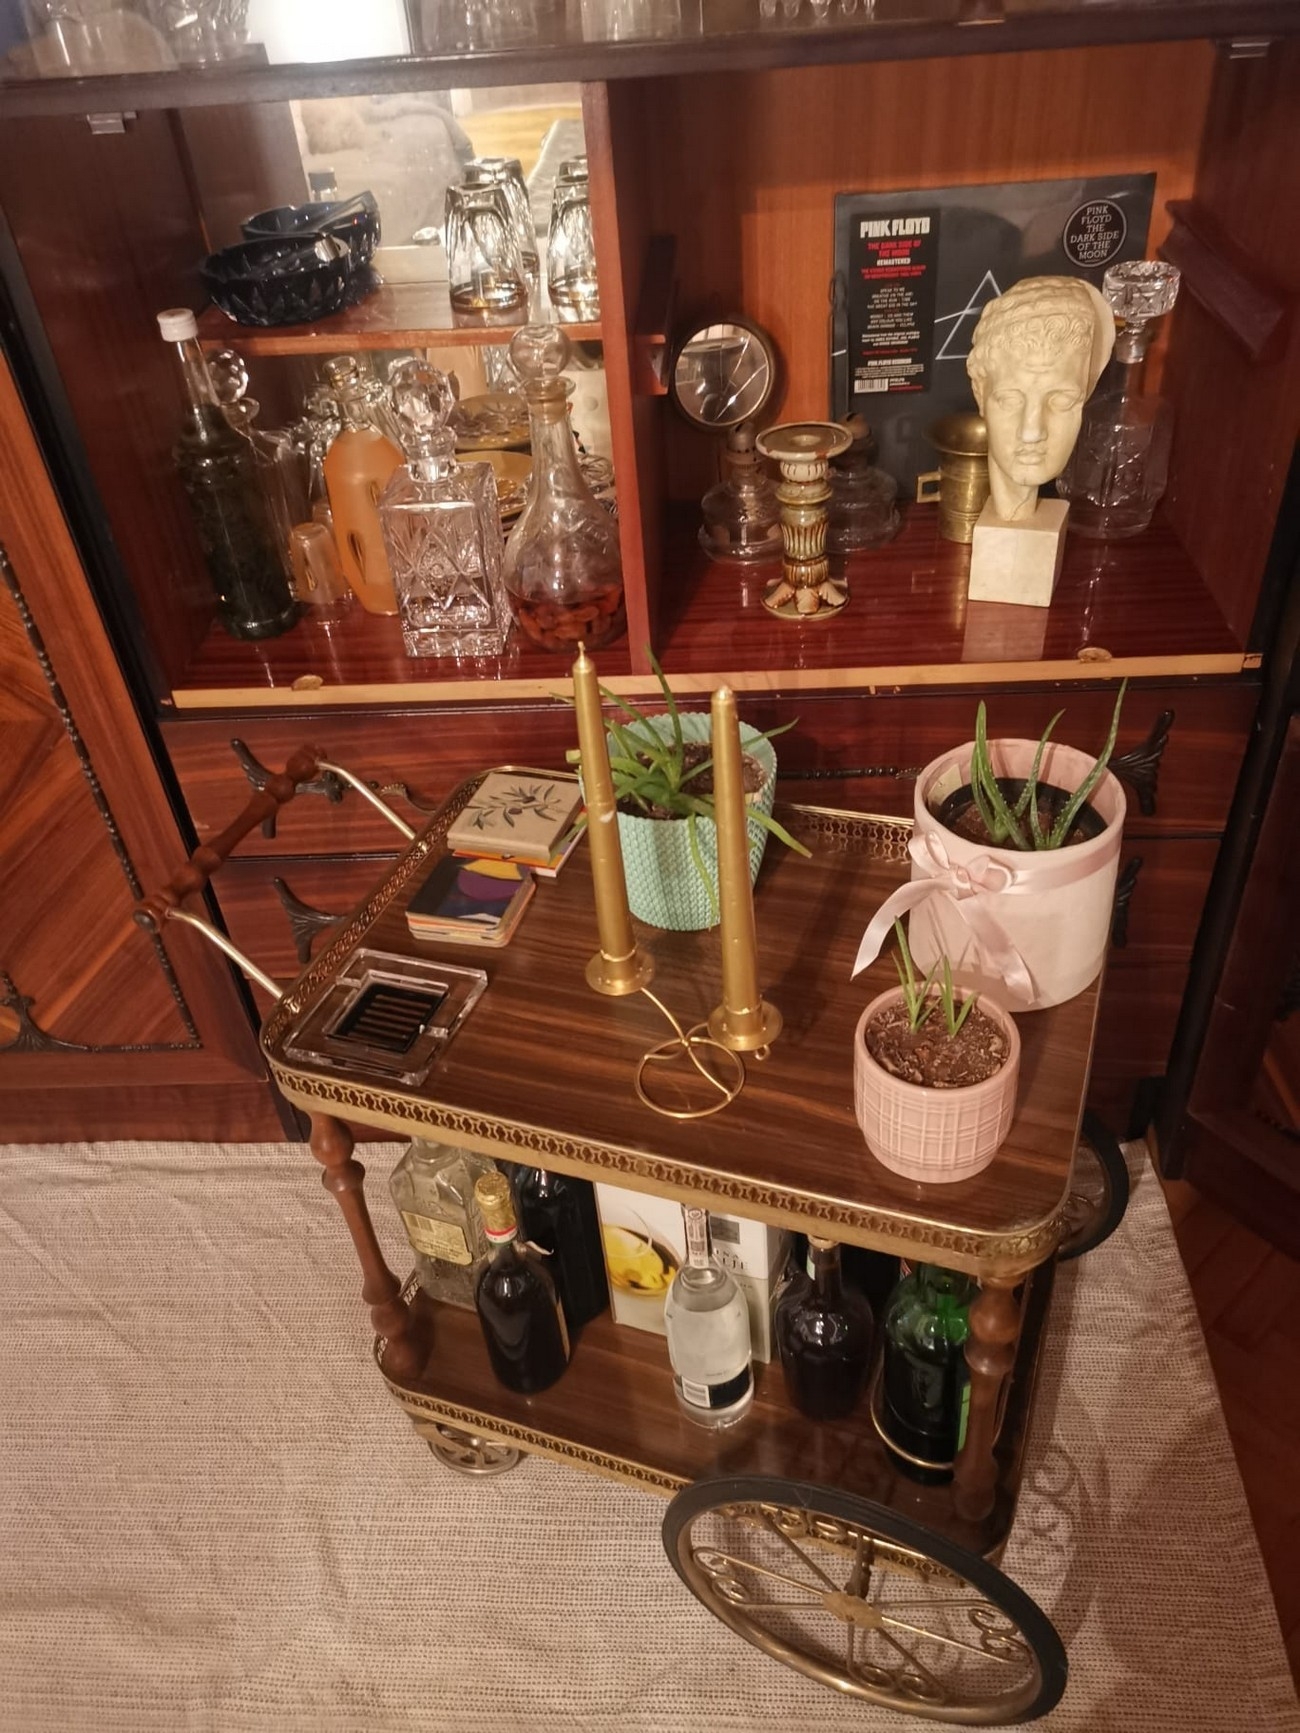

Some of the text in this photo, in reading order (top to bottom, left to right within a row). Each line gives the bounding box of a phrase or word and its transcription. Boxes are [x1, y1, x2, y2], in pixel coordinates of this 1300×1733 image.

[1086, 205, 1109, 215] PINK
[1081, 215, 1112, 225] FLOYD
[860, 217, 930, 239] PINK FLOYD
[1086, 223, 1105, 233] THE
[1070, 231, 1119, 243] DARK SIDE
[1077, 241, 1111, 251] OF THE
[1079, 250, 1108, 260] MOON
[877, 258, 911, 267] REMASTERED
